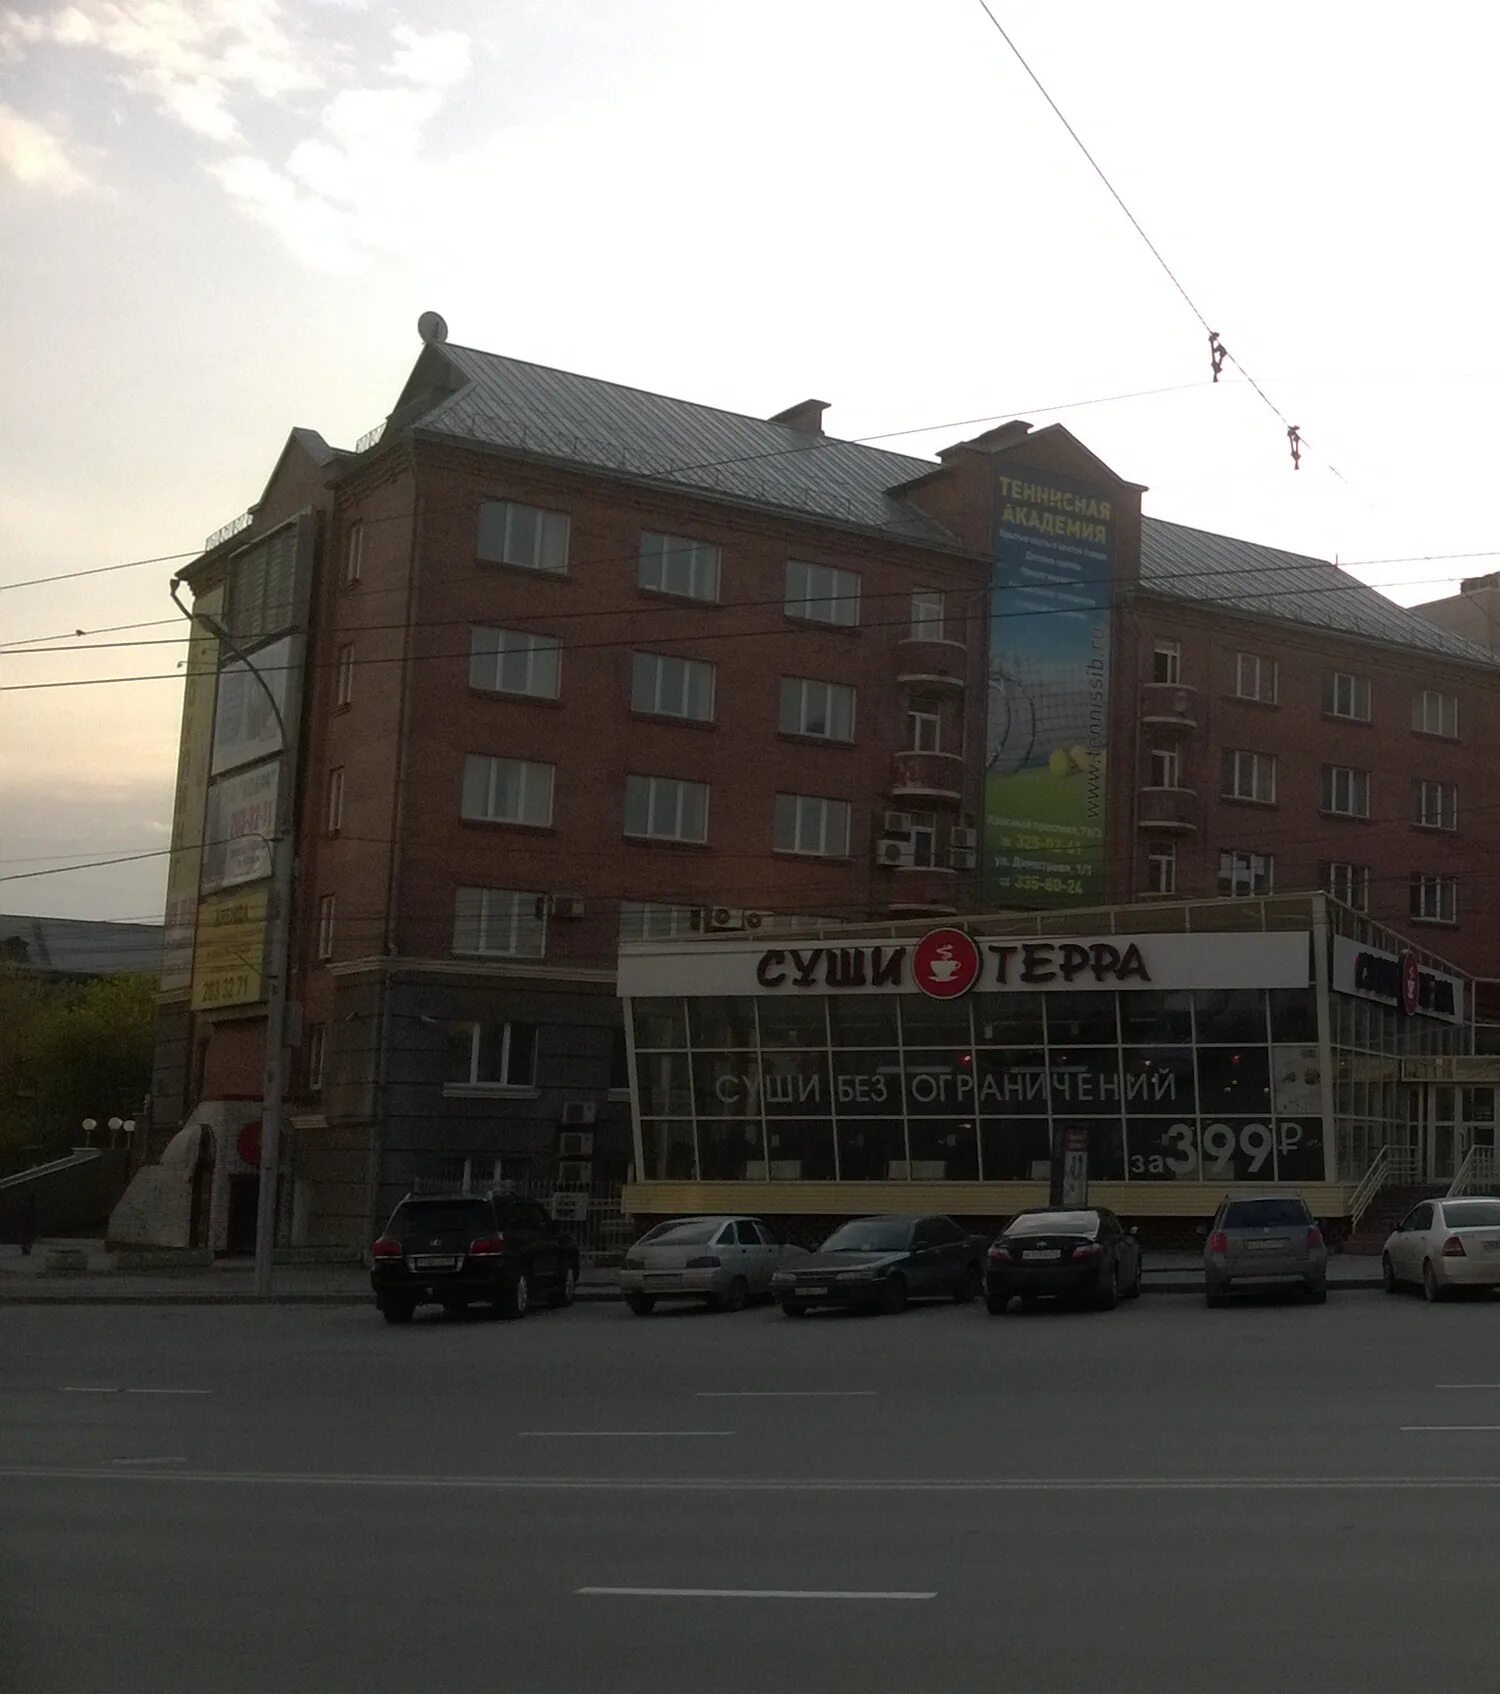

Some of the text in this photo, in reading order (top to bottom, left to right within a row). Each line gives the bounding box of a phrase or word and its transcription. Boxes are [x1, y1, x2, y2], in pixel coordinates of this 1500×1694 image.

[999, 475, 1111, 521] ТЕННИСНАЯ
[1002, 503, 1106, 544] АКАДЕМИЯ
[756, 942, 1152, 988] СУШИ ТЕРРА
[714, 1067, 1177, 1103] СУШИ БЕЗ ОГРАНИЧЕНИЙ
[1130, 1154, 1165, 1174] за
